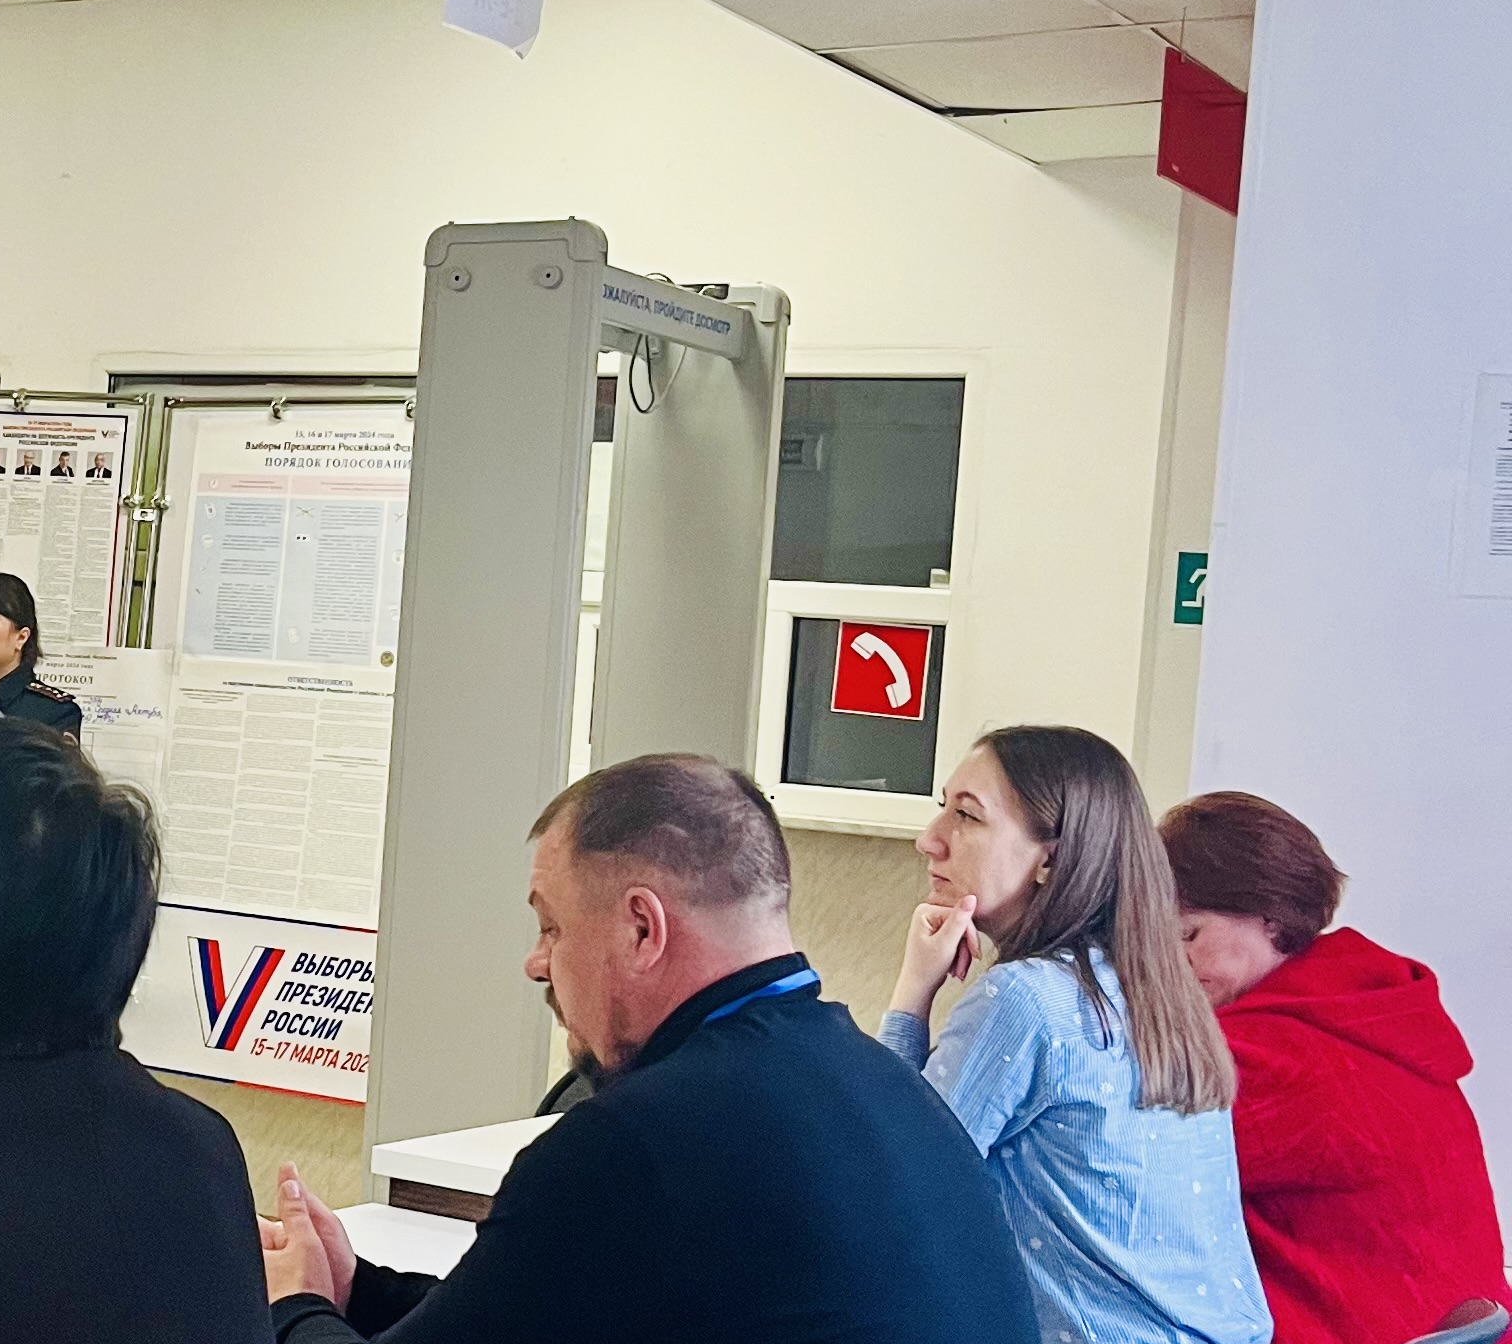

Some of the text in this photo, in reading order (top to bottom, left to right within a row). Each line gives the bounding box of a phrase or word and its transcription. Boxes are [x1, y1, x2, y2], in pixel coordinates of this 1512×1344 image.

[264, 457, 322, 468] ПОРЯДОК
[260, 1009, 343, 1041] РОССИИ
[289, 1043, 340, 1069] МАРТА
